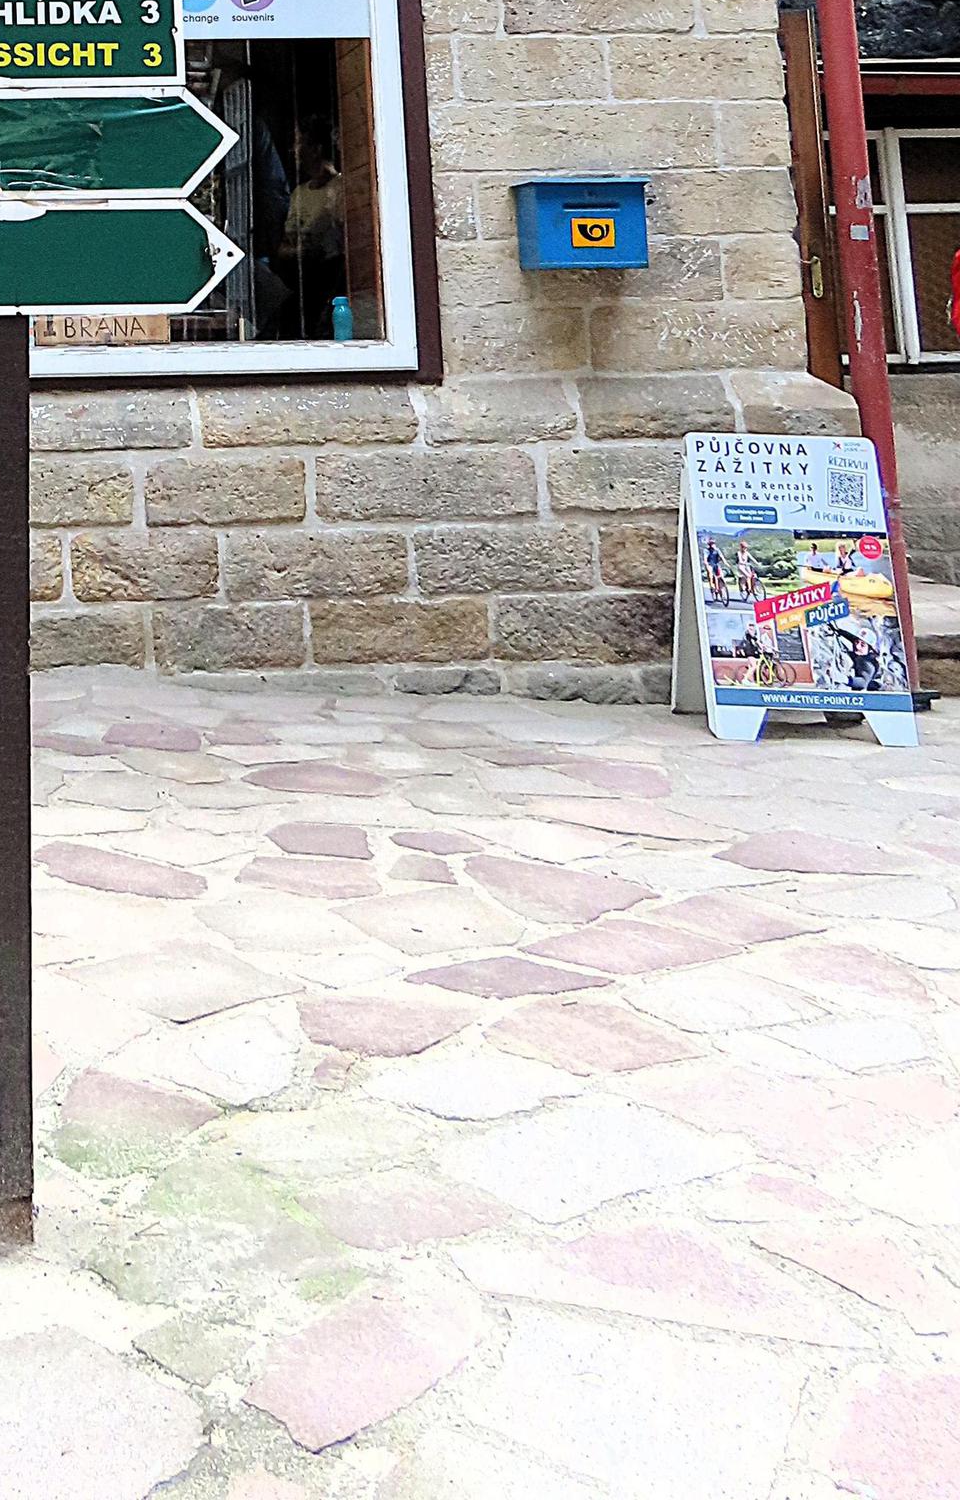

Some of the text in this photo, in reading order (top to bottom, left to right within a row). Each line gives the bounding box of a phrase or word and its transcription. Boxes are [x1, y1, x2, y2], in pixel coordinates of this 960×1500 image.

[140, 0, 160, 24] 3
[231, 13, 275, 22] souvenirs
[143, 43, 163, 66] 3
[695, 437, 808, 456] PŮJČOVNA
[696, 457, 809, 475] ZÁŽITKY
[699, 480, 813, 491] Tours & Rentals
[700, 491, 814, 502] Touren & Verleih
[778, 586, 826, 612] ZÁŽITKY
[809, 602, 845, 623] PŮJČIT
[762, 693, 864, 706] WWW.ACTIVE-POINT.CZ
